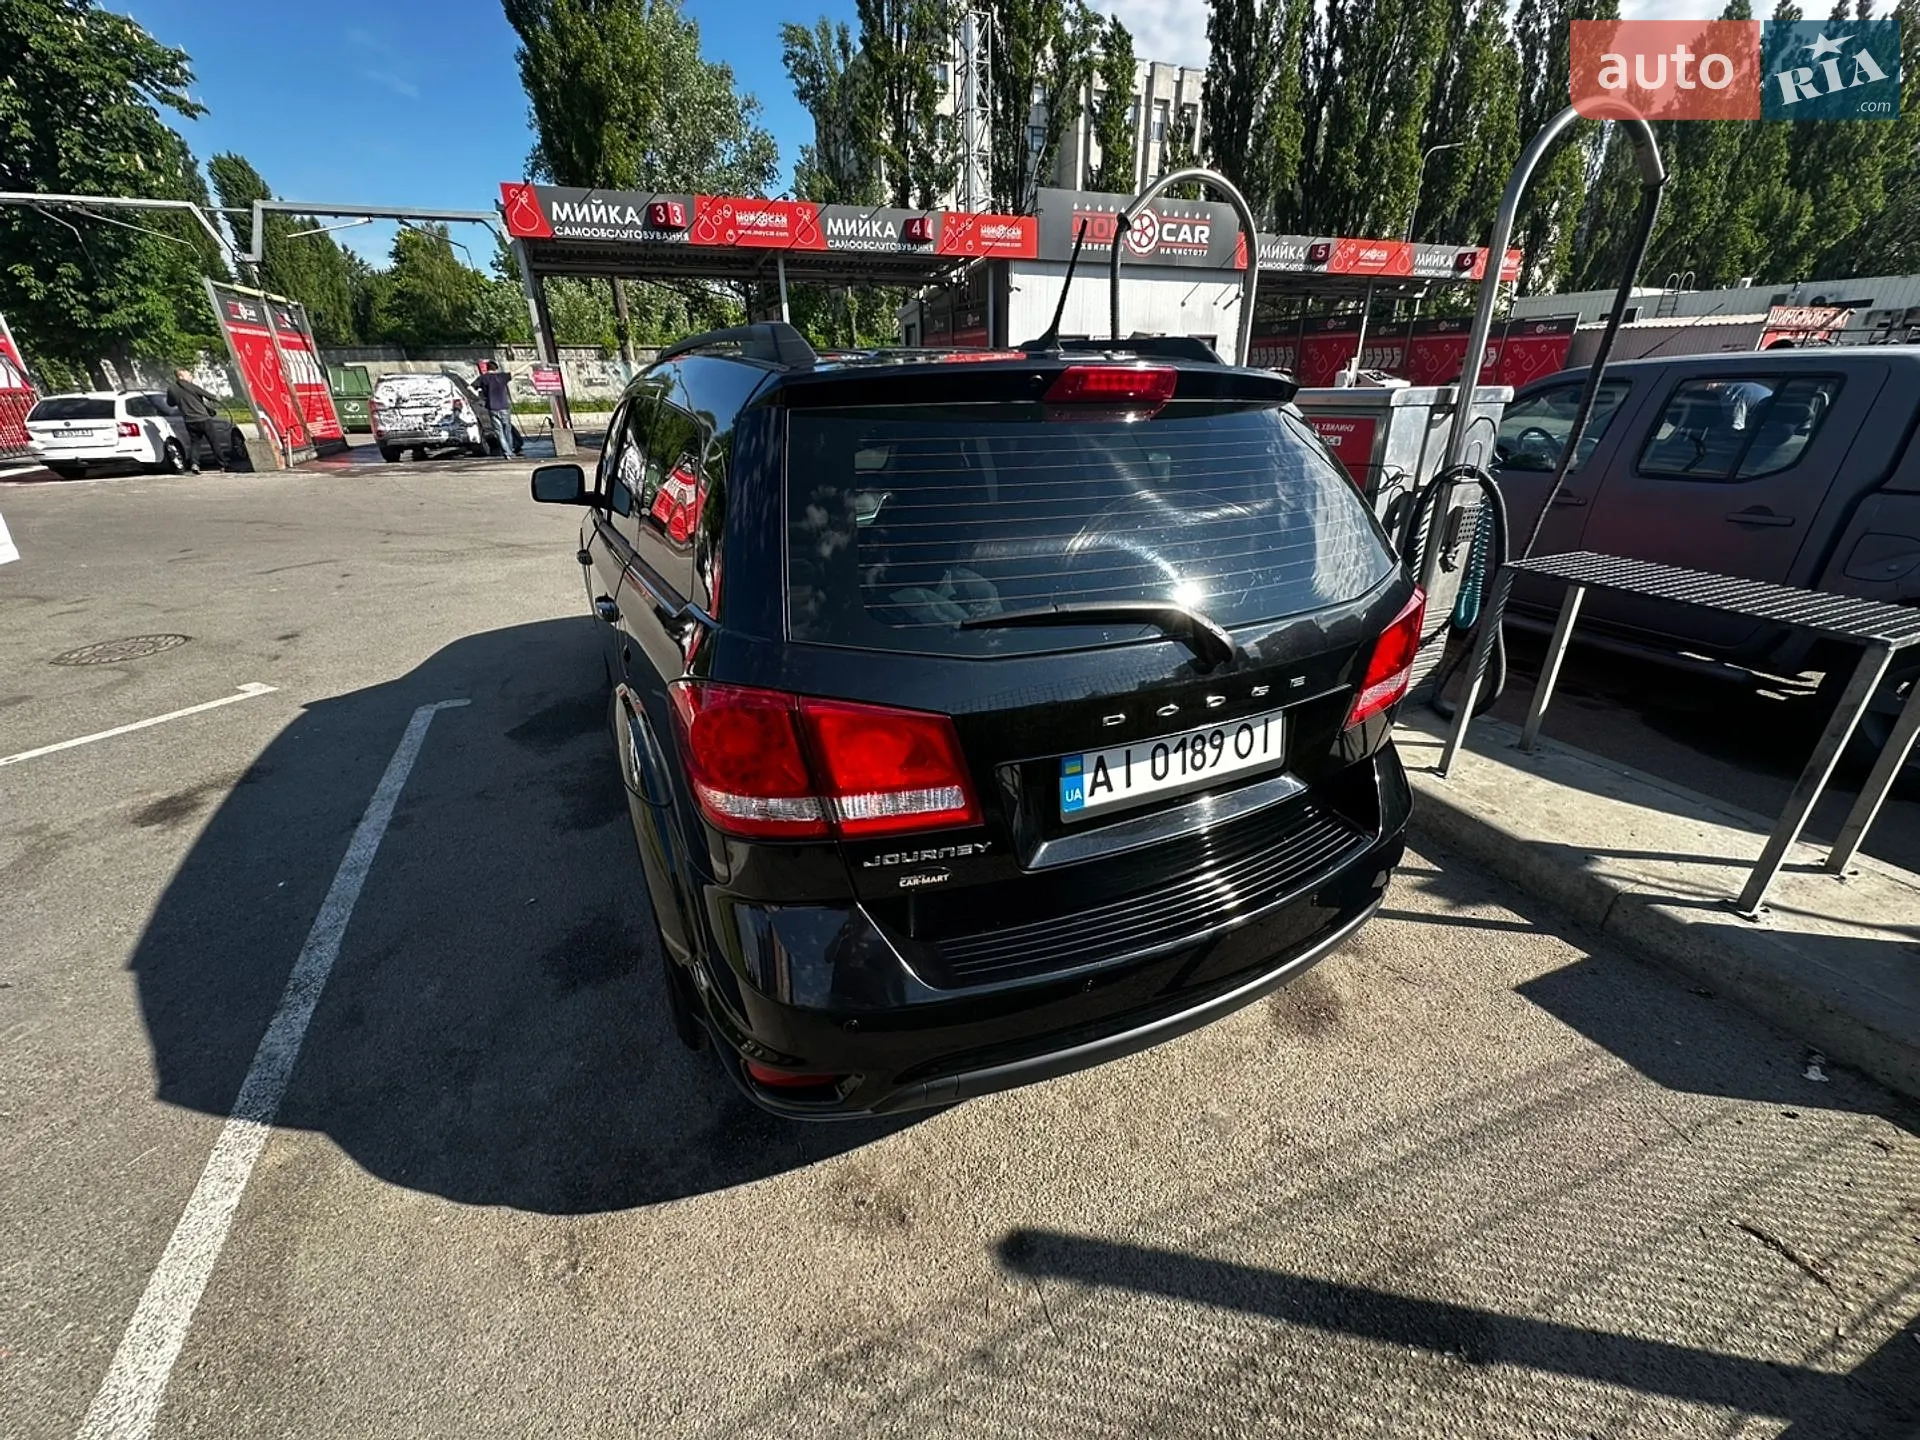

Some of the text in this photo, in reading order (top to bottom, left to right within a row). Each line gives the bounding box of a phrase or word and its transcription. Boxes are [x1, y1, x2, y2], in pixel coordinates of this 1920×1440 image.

[552, 199, 683, 225] МИЙКА 3 3
[554, 225, 690, 241] САМООБСЛУГОВУВАННЯ
[826, 213, 898, 239] МИЙКА
[911, 219, 921, 236] 4
[1162, 223, 1210, 244] CAR
[1160, 247, 1171, 255] НА
[1259, 241, 1327, 260] МИЙКА 5
[1414, 250, 1471, 268] МИЙКА 6
[1102, 676, 1307, 727] DODGE
[1065, 717, 1269, 803] UA AI 0189 OI
[863, 841, 992, 868] JOURNEY
